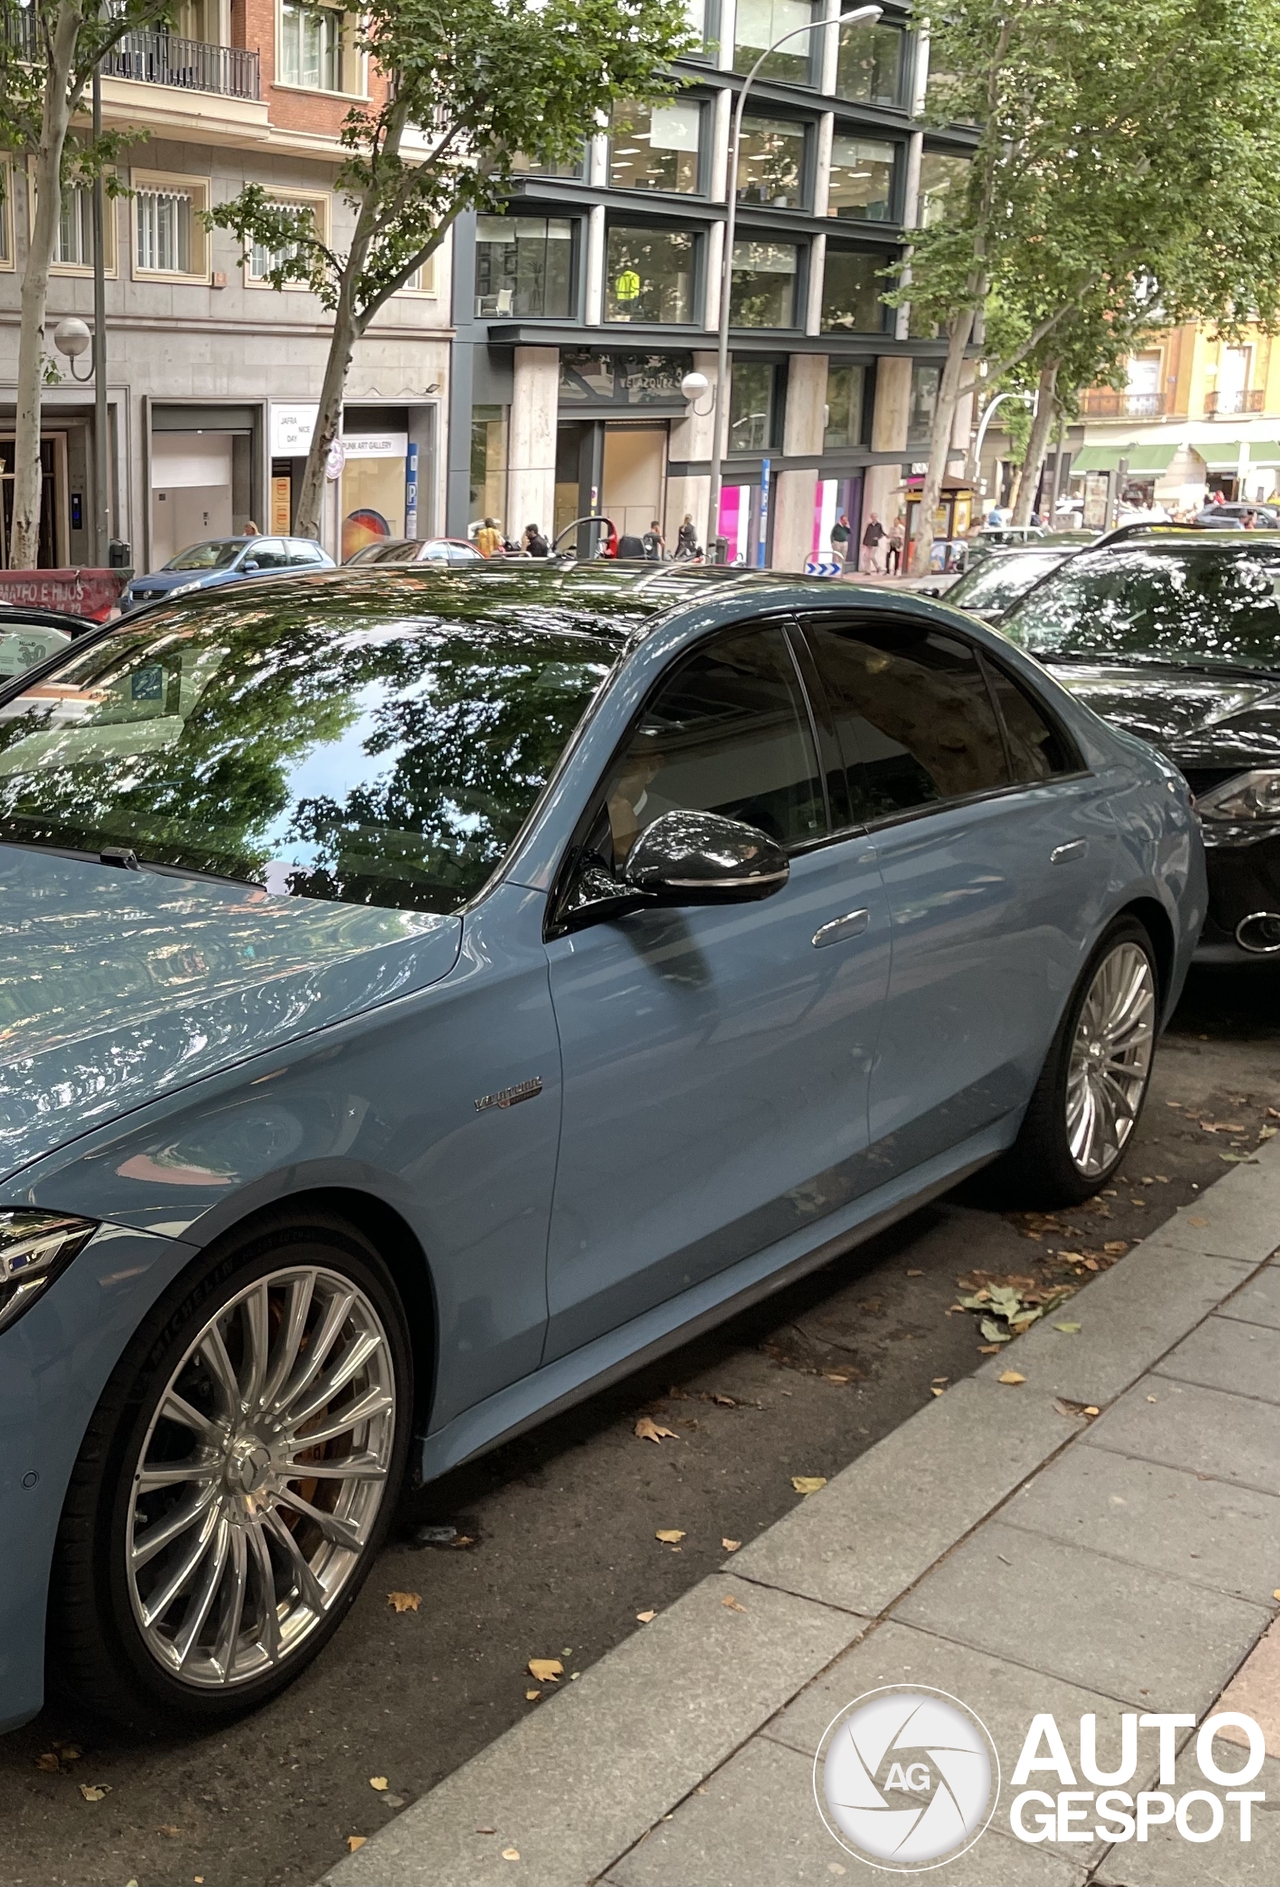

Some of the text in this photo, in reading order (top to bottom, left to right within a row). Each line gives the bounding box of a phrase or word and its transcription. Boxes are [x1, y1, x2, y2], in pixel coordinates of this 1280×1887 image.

[287, 435, 297, 443] DAY
[368, 441, 392, 450] GALLERY
[41, 583, 49, 601] E
[52, 583, 84, 601] HIJOS
[150, 1258, 235, 1366] MICHELIN
